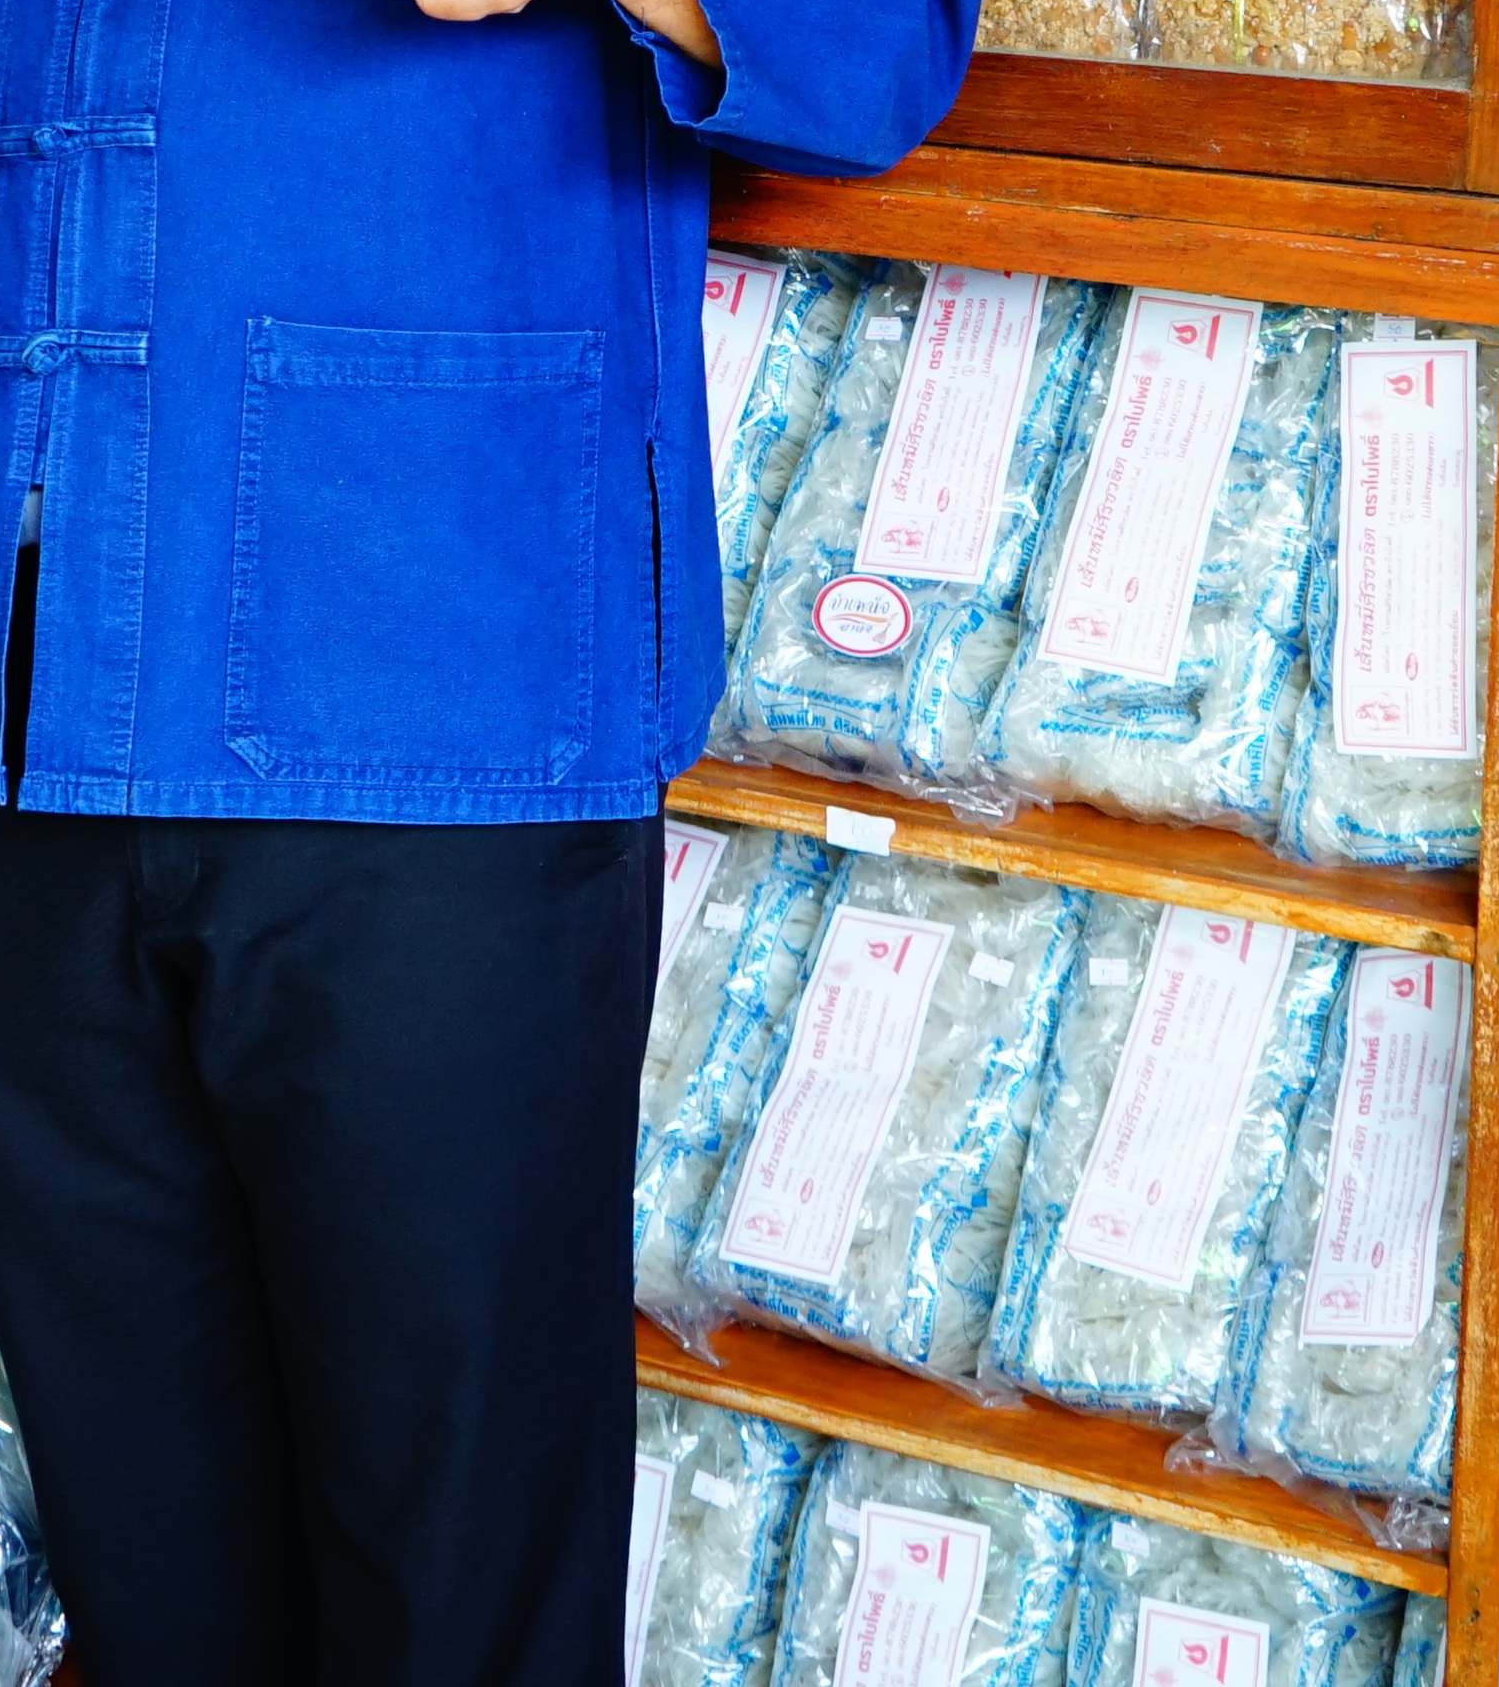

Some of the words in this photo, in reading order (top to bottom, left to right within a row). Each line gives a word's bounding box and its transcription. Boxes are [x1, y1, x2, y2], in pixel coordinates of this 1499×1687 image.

[929, 298, 957, 370] ตราใบโพธิ์
[1122, 373, 1153, 450] ตราใบโพธิ์
[1359, 434, 1380, 517] ตราใบโพธิ์
[811, 984, 842, 1061] ตราใบโพธิ์
[1151, 966, 1186, 1047] ตราใบโพธิ์
[1353, 1033, 1382, 1117] ตราใบโพธิ์
